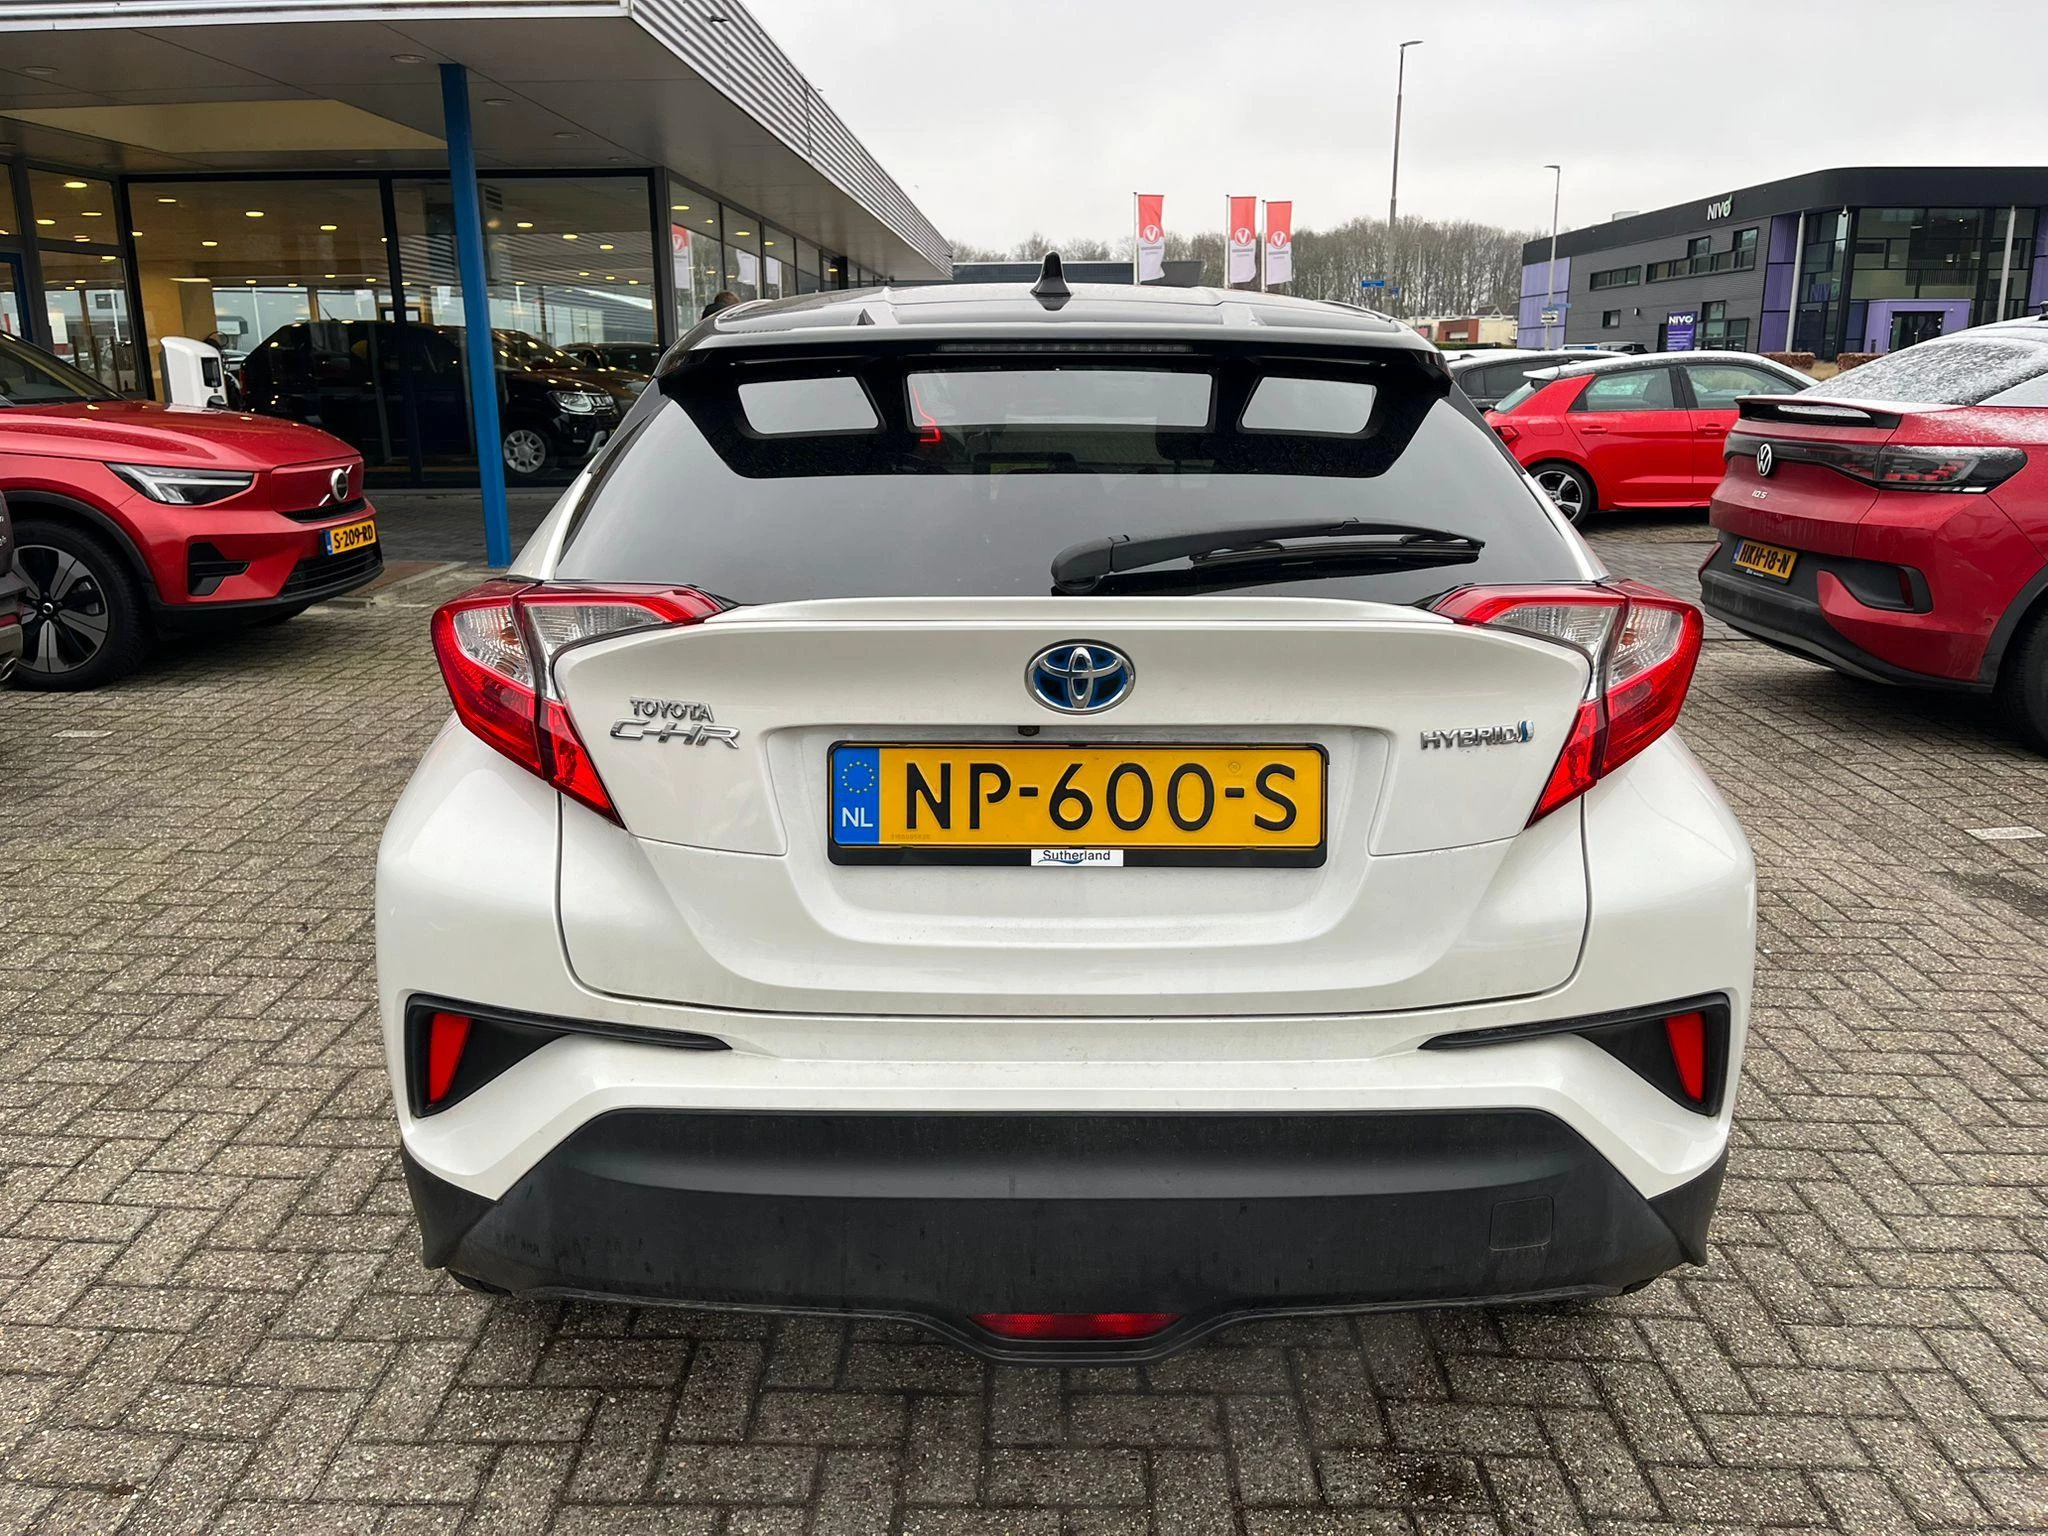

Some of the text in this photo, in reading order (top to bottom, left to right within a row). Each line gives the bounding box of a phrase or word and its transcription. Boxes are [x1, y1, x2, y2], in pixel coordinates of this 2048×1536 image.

[1707, 196, 1732, 220] NIVO
[1668, 315, 1693, 325] NIVO
[333, 524, 373, 549] S-209-RD
[1739, 543, 1791, 574] HKH-18-N
[630, 697, 714, 723] TOYOTA
[610, 718, 740, 749] C-HR
[1420, 725, 1521, 750] HYBRID
[906, 762, 1297, 831] NP-600-S
[841, 807, 874, 828] NL
[1042, 849, 1111, 861] Sutherland
